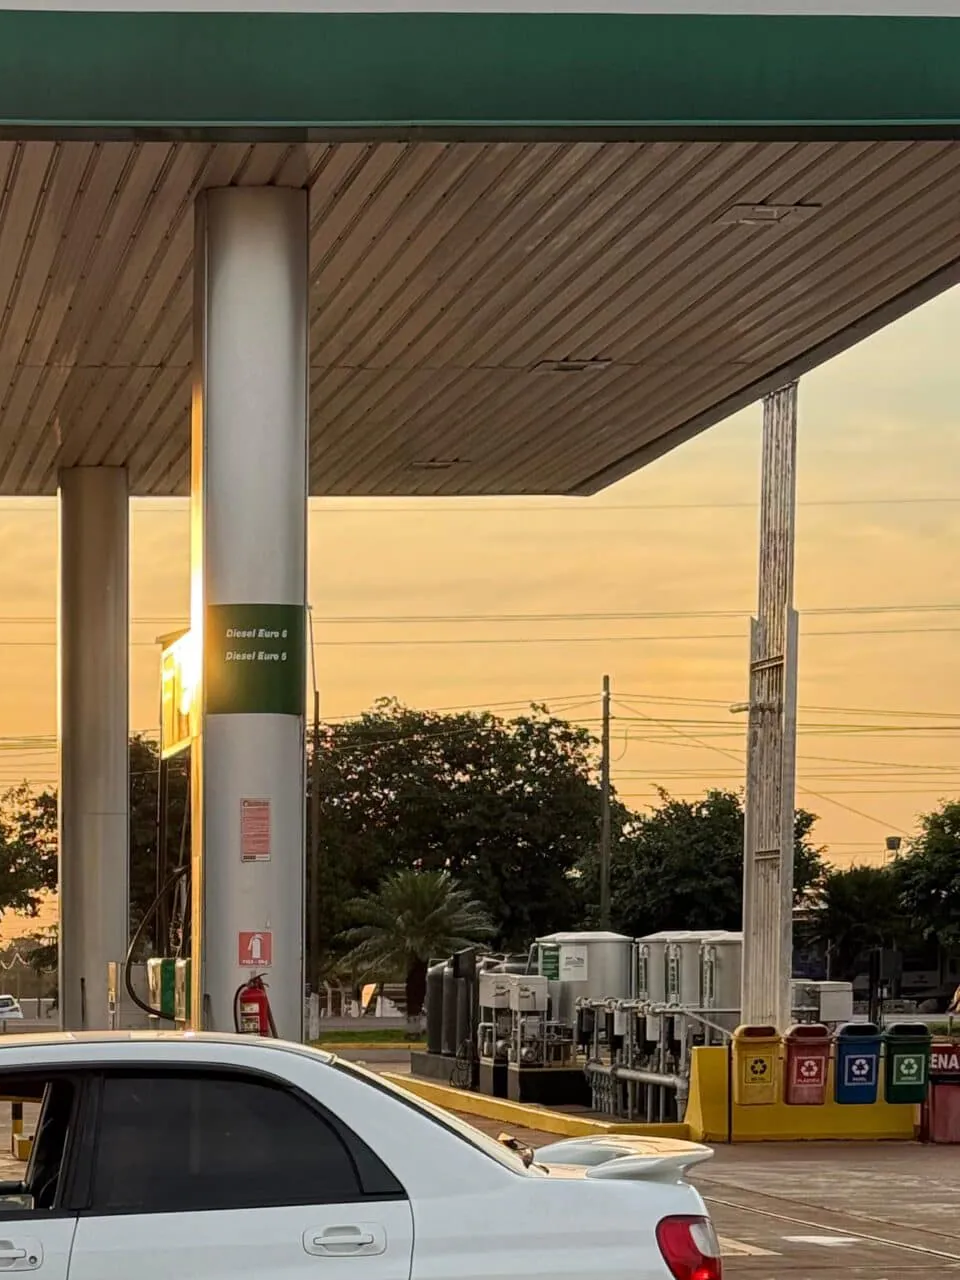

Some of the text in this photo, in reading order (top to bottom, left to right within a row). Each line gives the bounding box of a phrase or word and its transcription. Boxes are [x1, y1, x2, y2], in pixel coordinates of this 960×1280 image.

[226, 628, 256, 638] Diesel
[258, 628, 279, 638] Euro
[225, 651, 256, 661] Diesel
[258, 651, 279, 661] Euro
